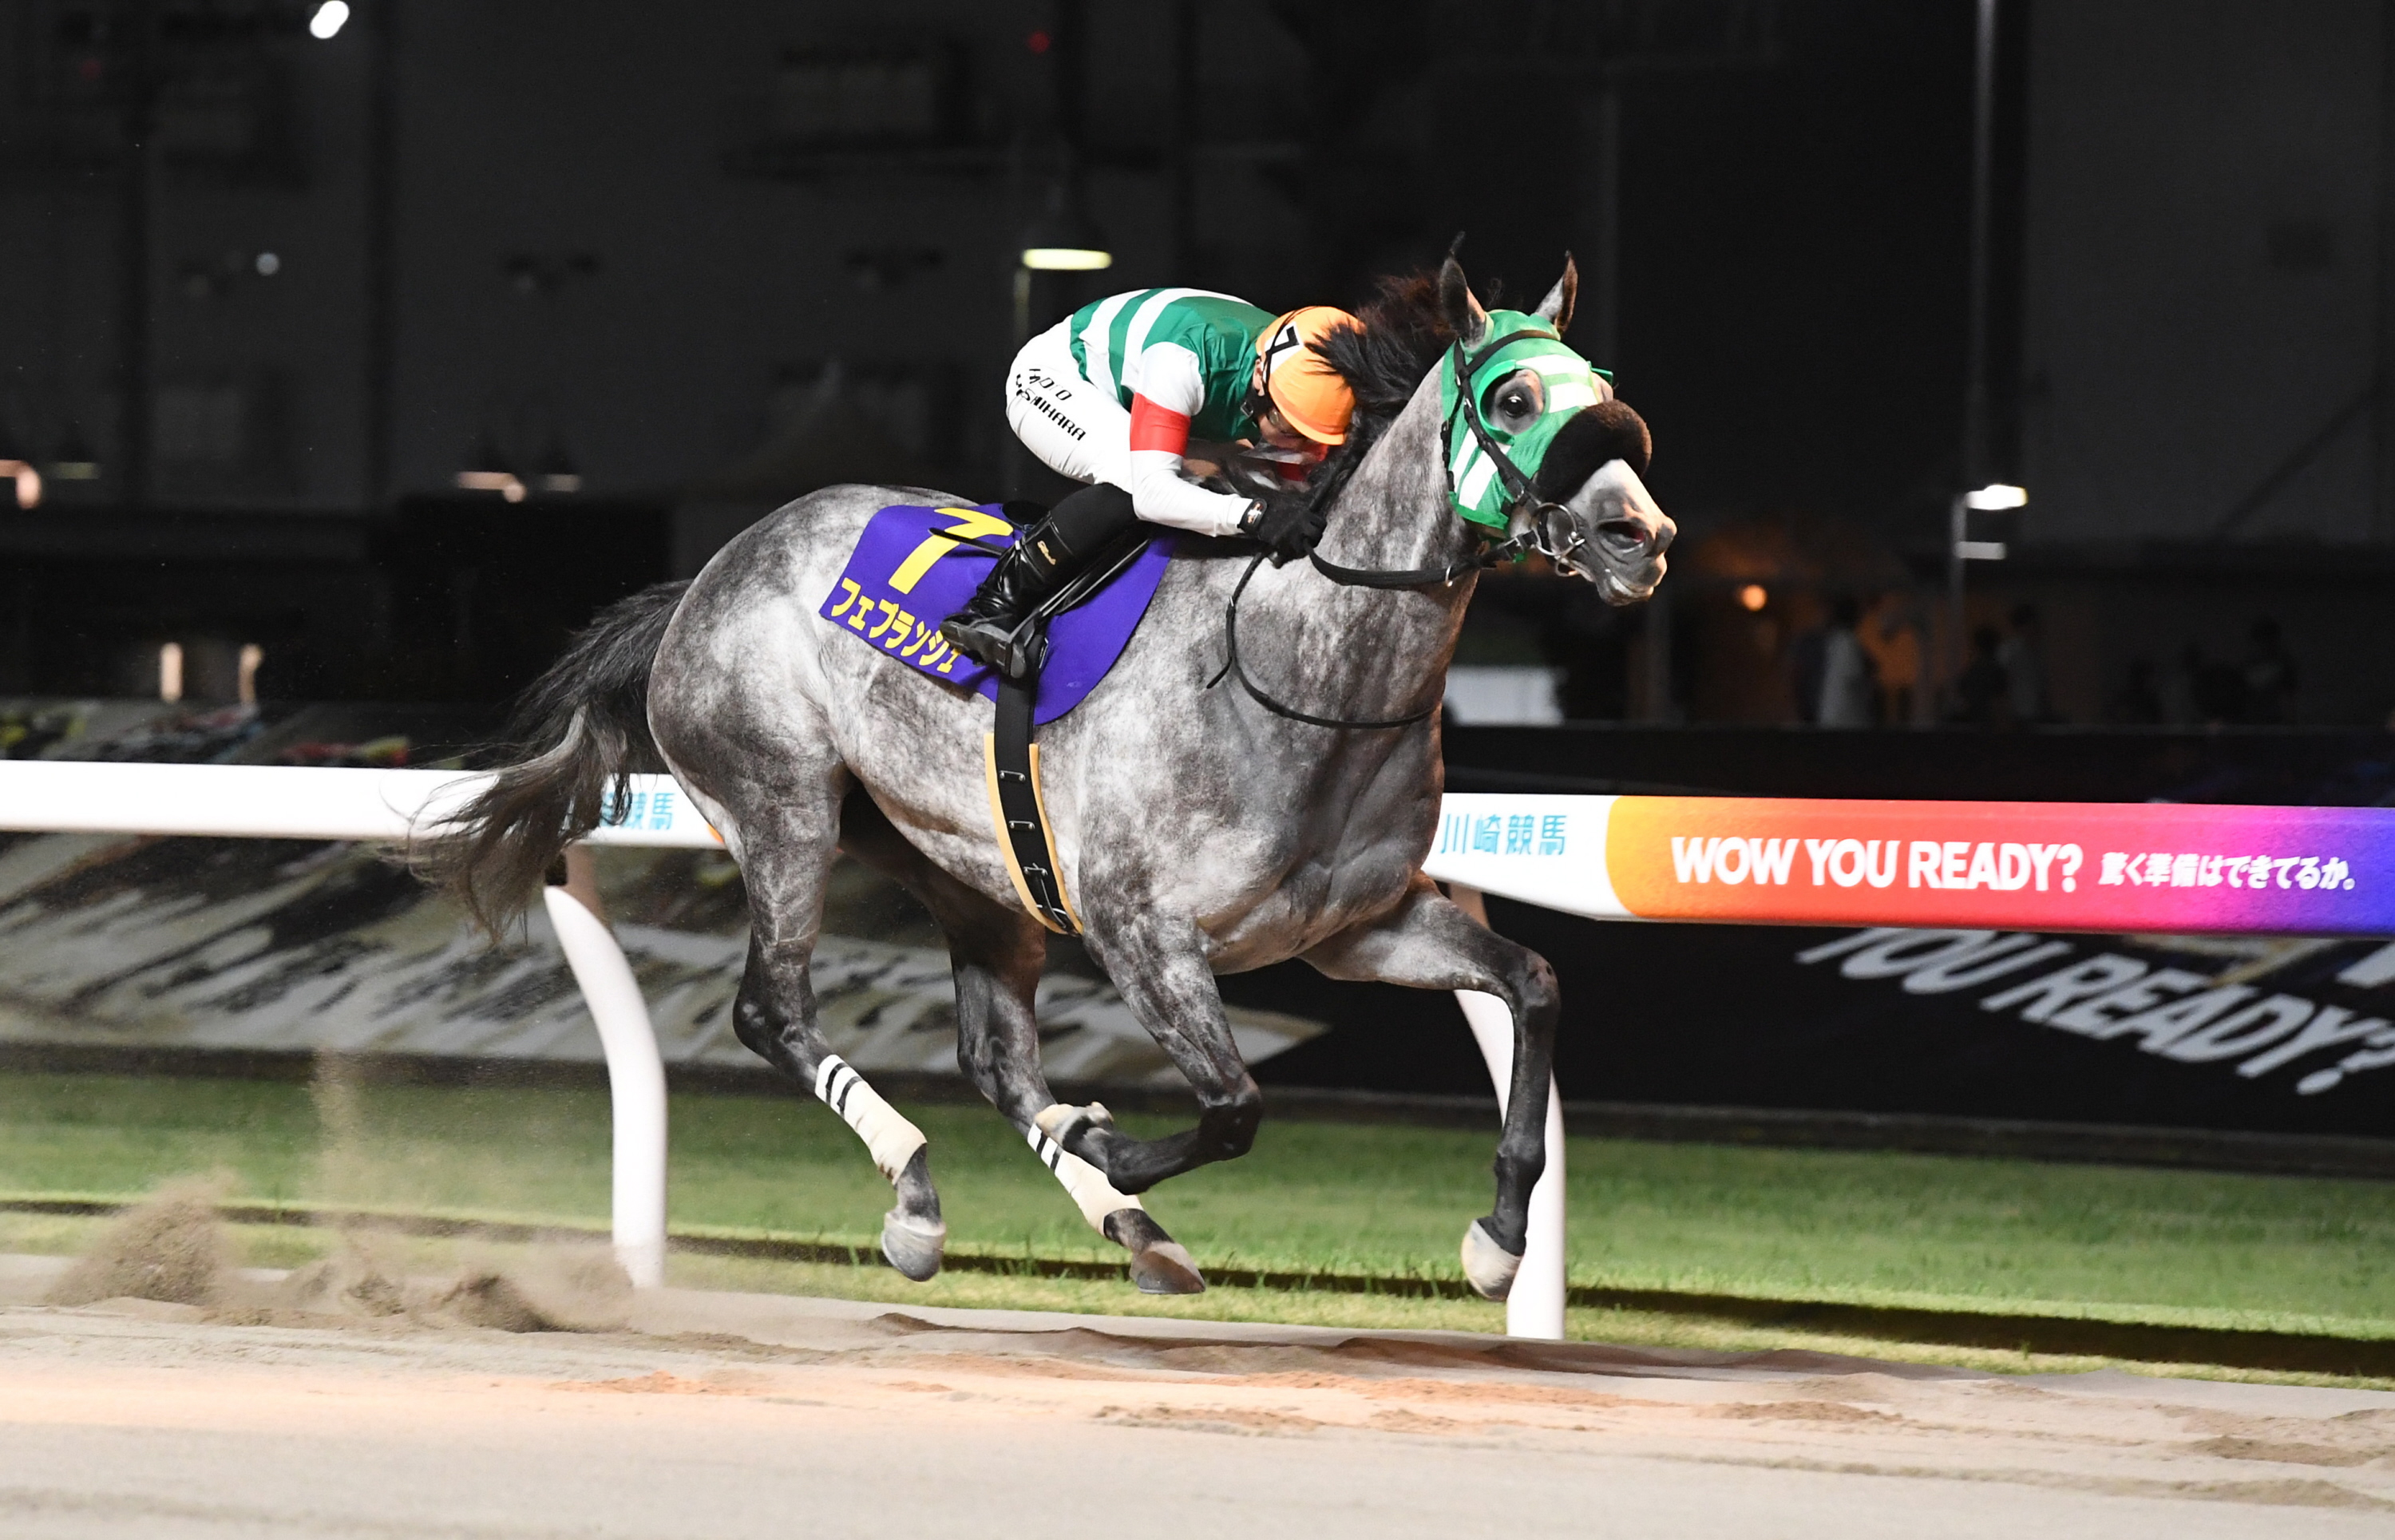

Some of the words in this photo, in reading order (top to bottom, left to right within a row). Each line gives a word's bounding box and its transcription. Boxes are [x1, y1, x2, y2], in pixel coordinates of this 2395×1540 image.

[888, 507, 1014, 595] 7
[1440, 814, 1567, 856] 川崎競馬
[1671, 836, 1800, 885] WOW
[1803, 838, 1901, 889] YOU
[1908, 841, 2084, 893] READY?
